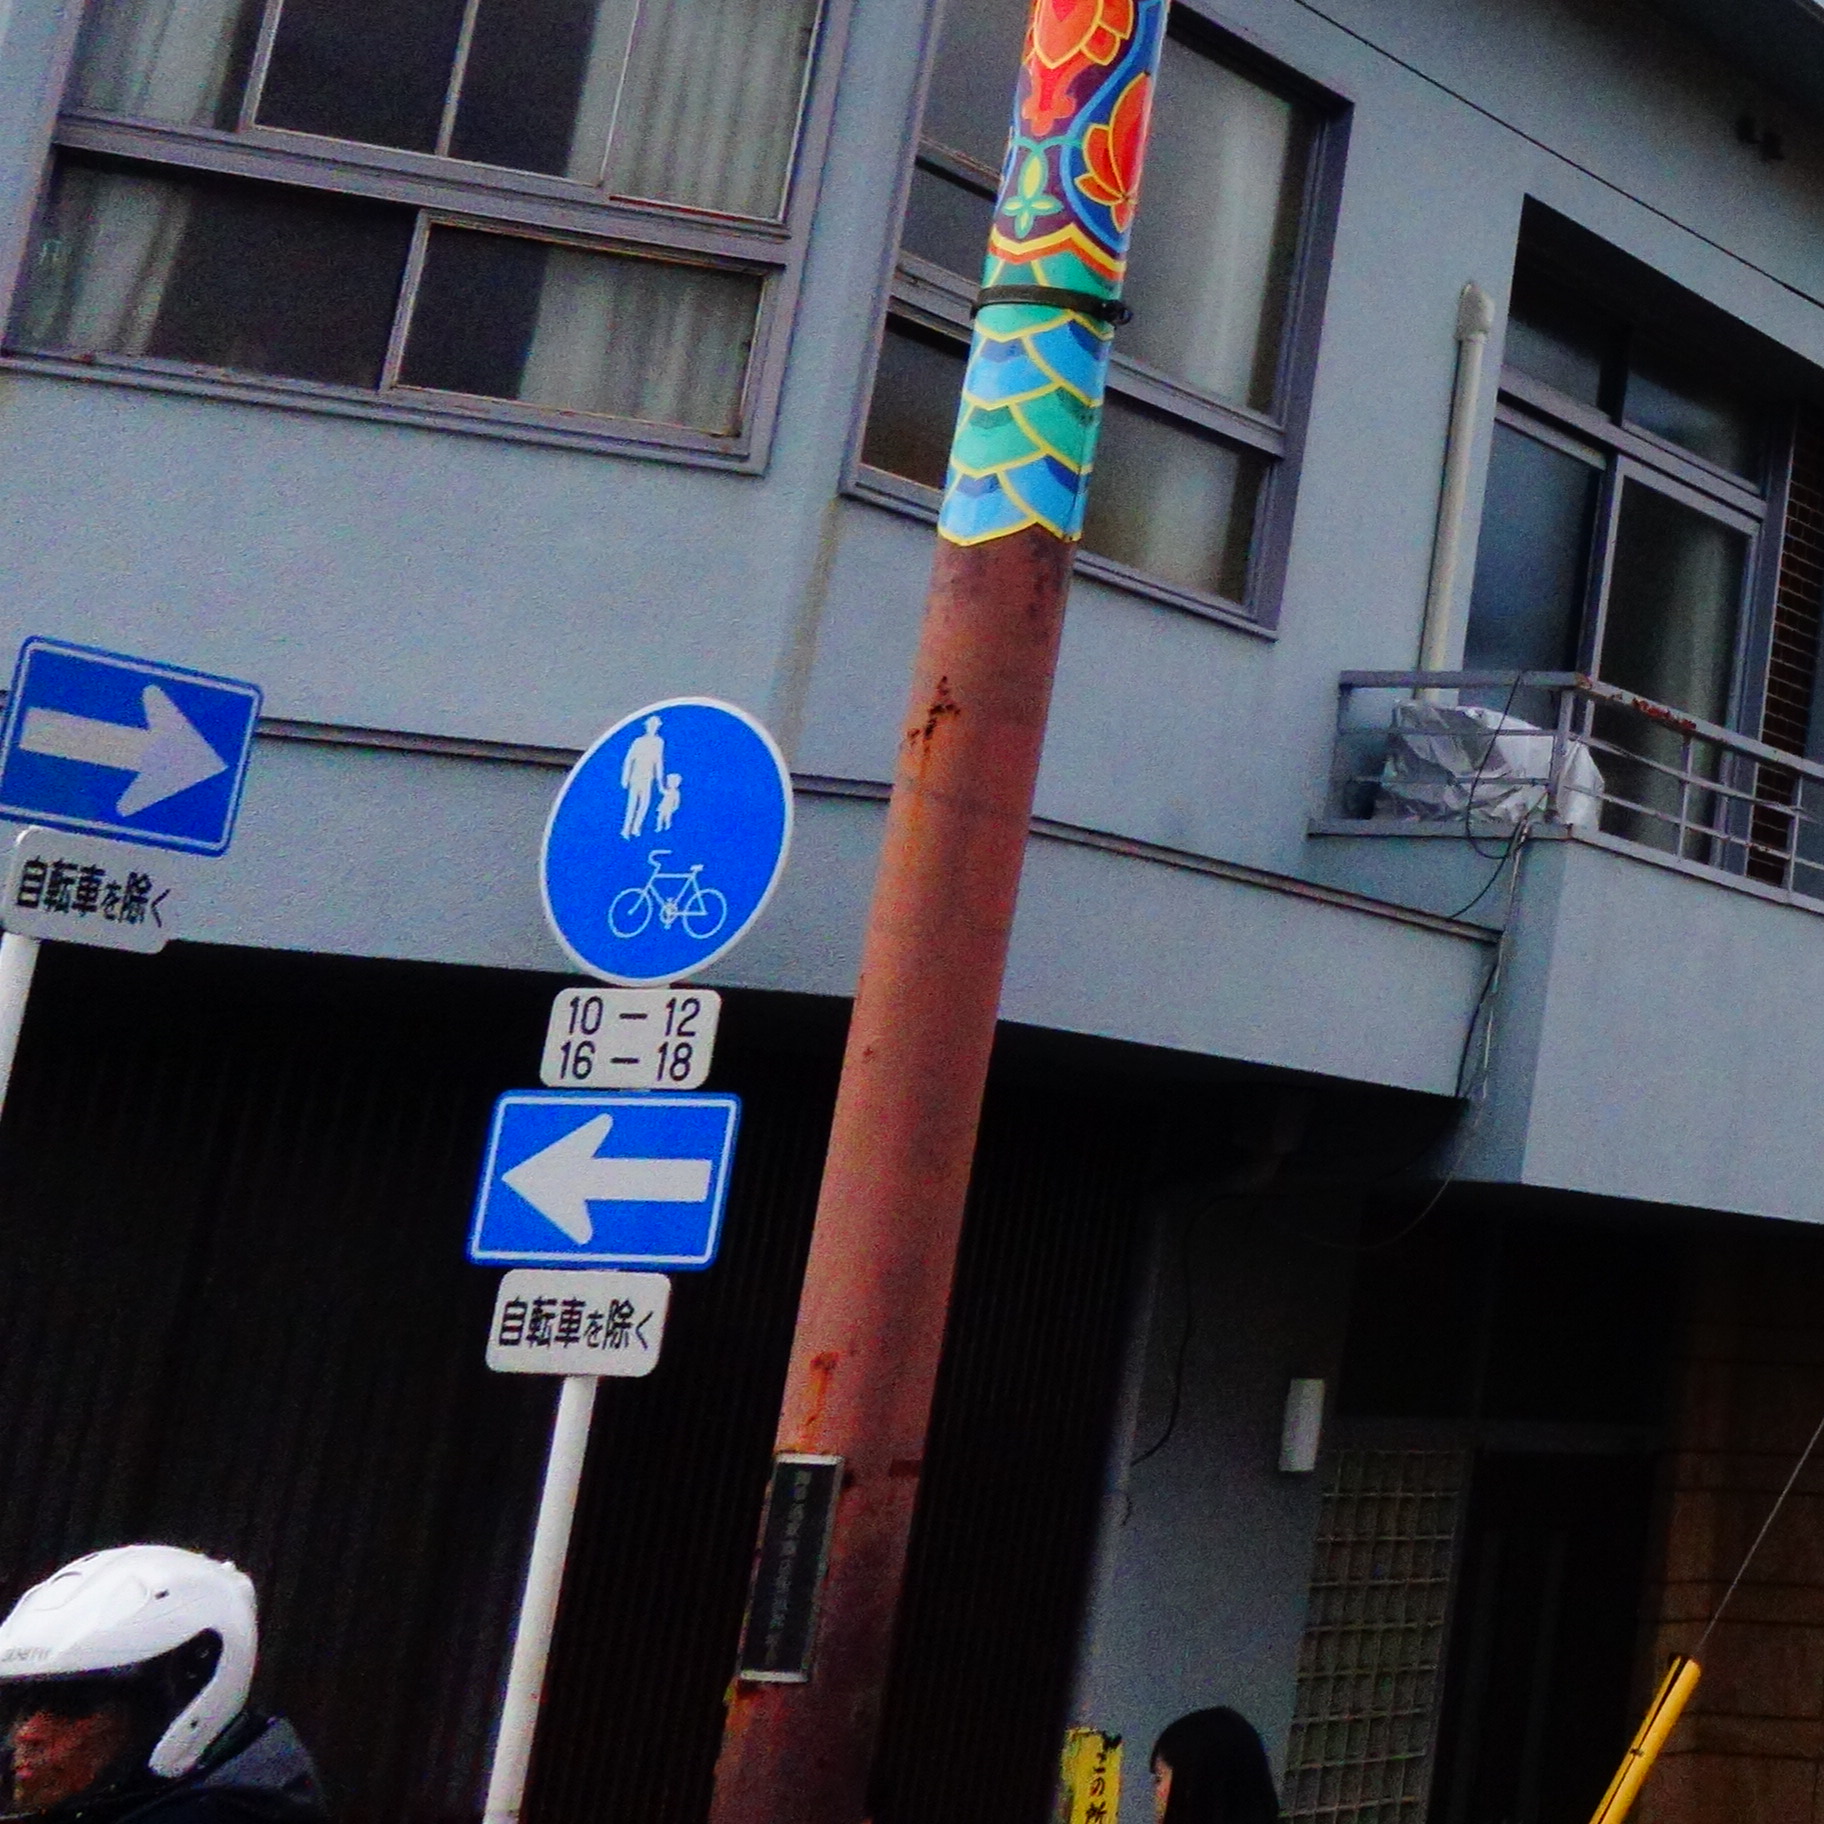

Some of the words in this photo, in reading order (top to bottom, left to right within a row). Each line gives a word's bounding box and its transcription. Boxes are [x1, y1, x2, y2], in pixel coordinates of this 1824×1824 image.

[16, 855, 172, 928] 自転車を除く
[499, 1295, 654, 1351] 自転車を除く
